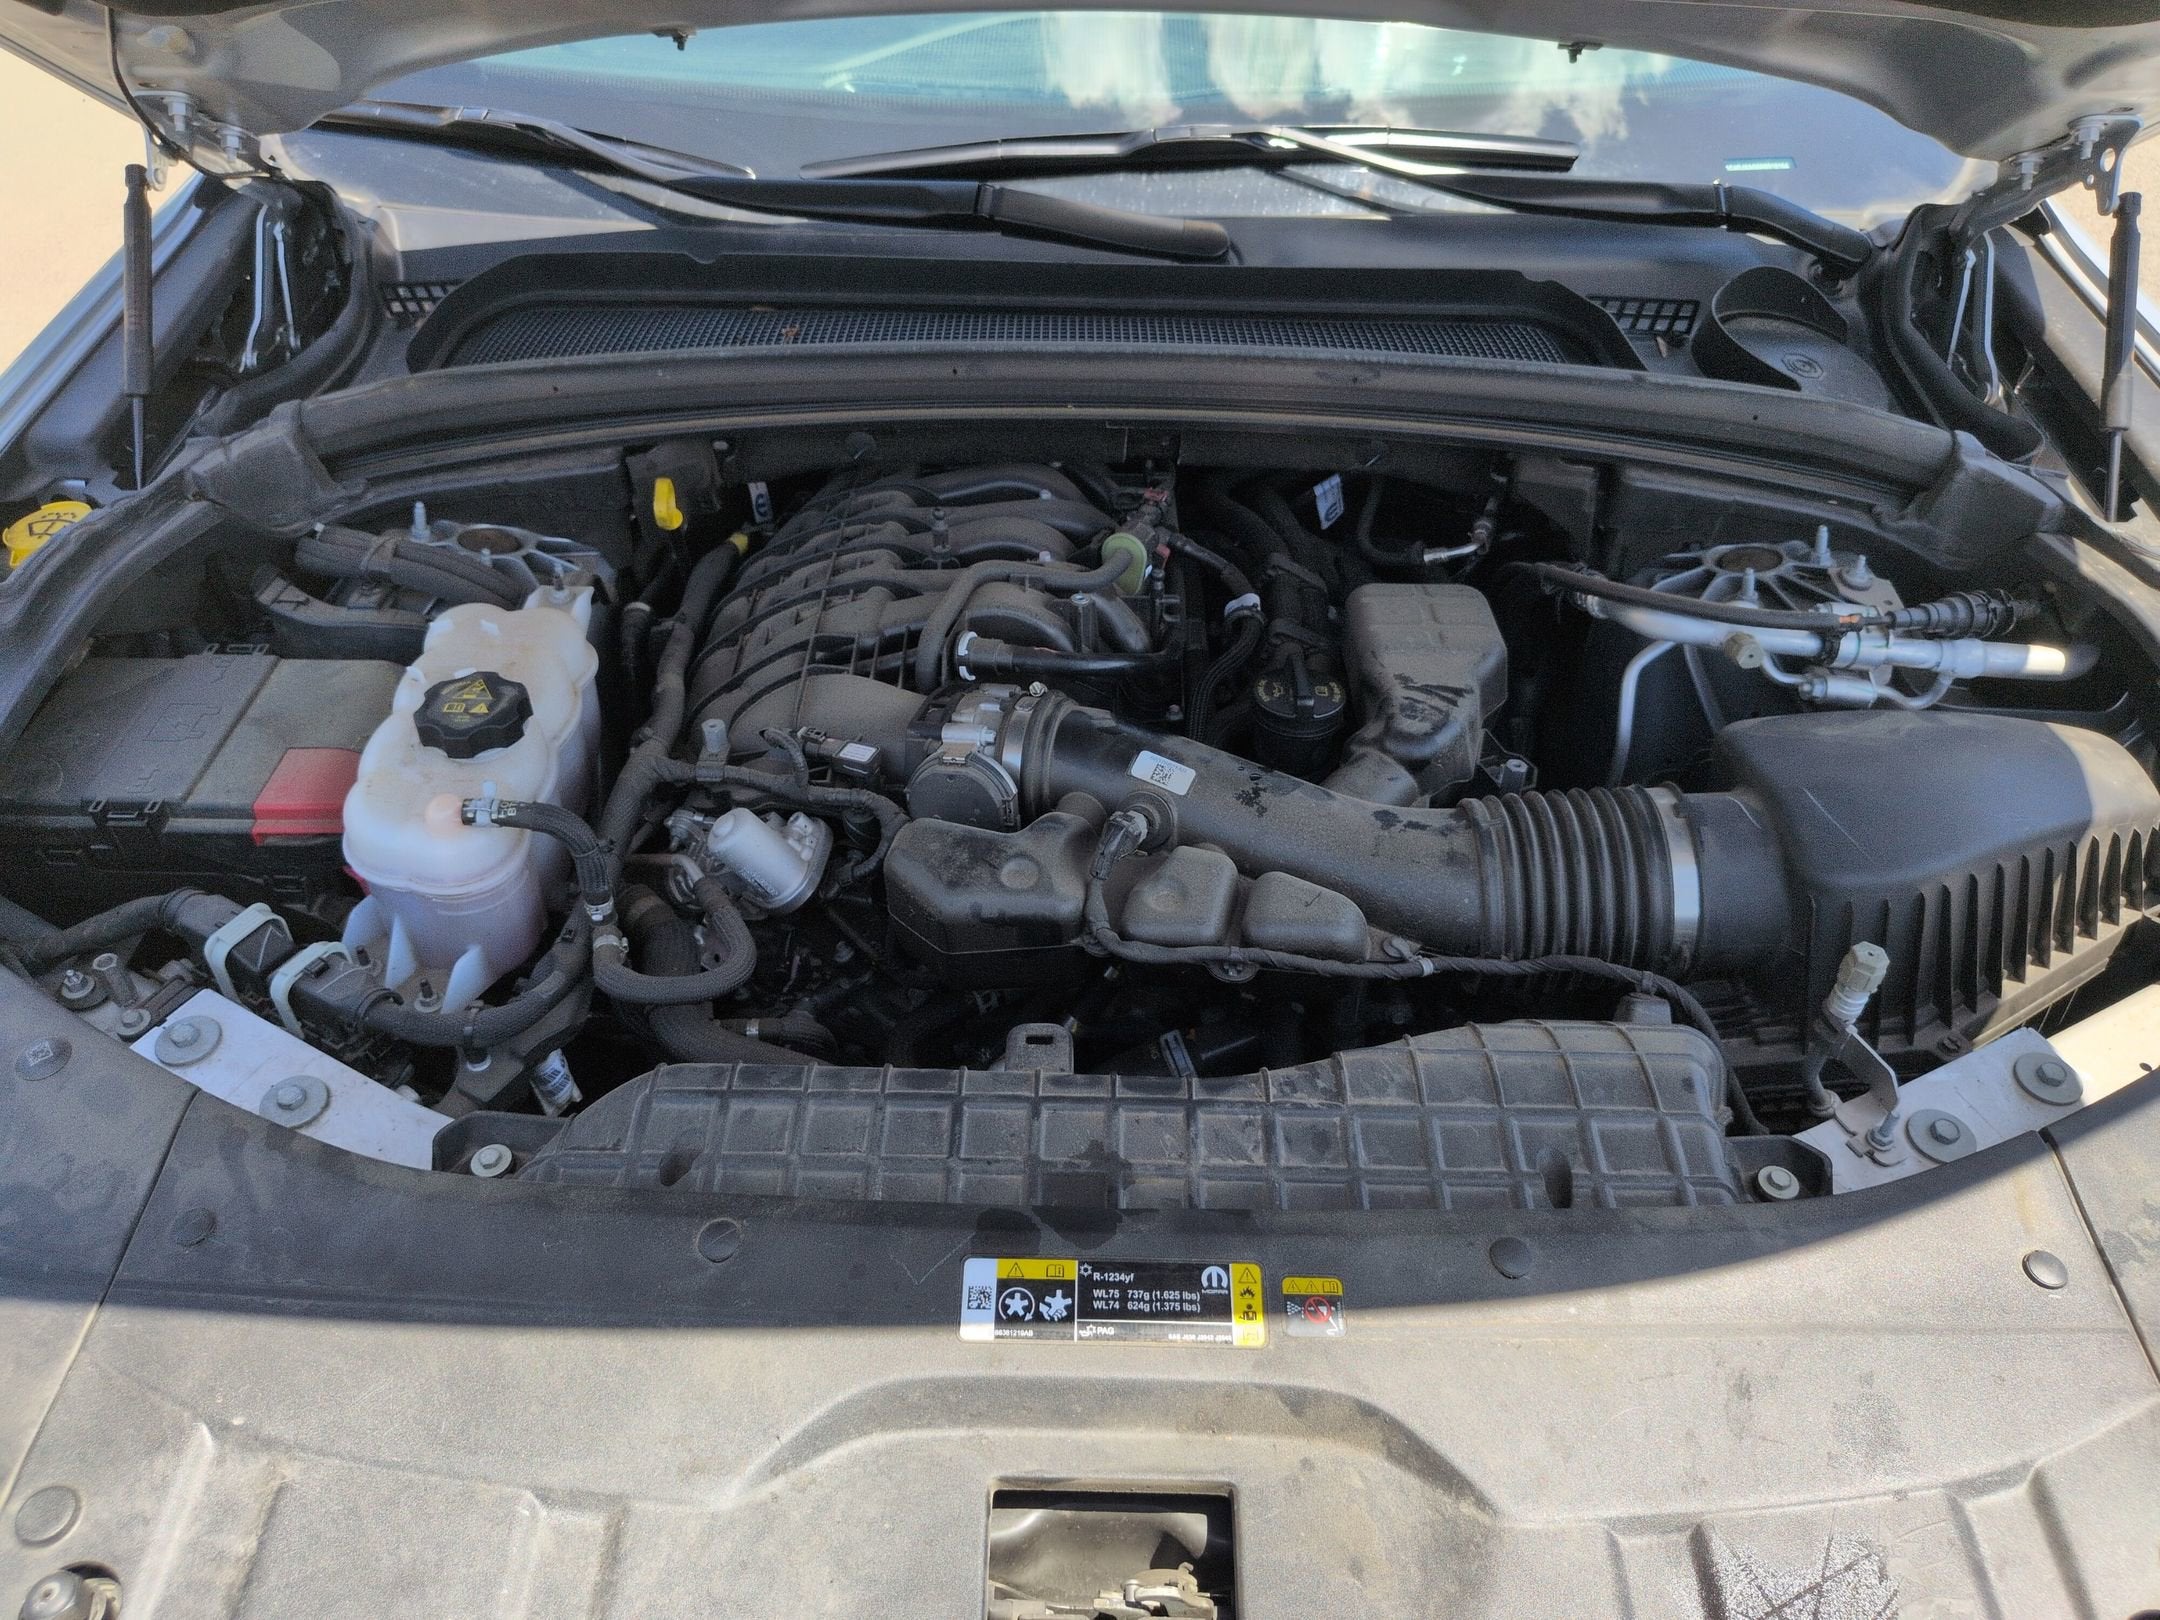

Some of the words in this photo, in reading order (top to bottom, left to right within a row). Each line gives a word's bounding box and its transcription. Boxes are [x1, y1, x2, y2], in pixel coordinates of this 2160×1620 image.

[1093, 1272, 1134, 1284] R-1234yf
[1093, 1289, 1120, 1299] WL75
[1127, 1290, 1150, 1301] 737g
[1152, 1290, 1180, 1301] (1.625
[1182, 1290, 1200, 1302] lbs)
[1093, 1300, 1120, 1310] WL74
[1127, 1301, 1150, 1312] 624g
[1152, 1301, 1180, 1313] (1.375
[1182, 1302, 1201, 1313] lbs)
[1097, 1326, 1115, 1336] PAG
